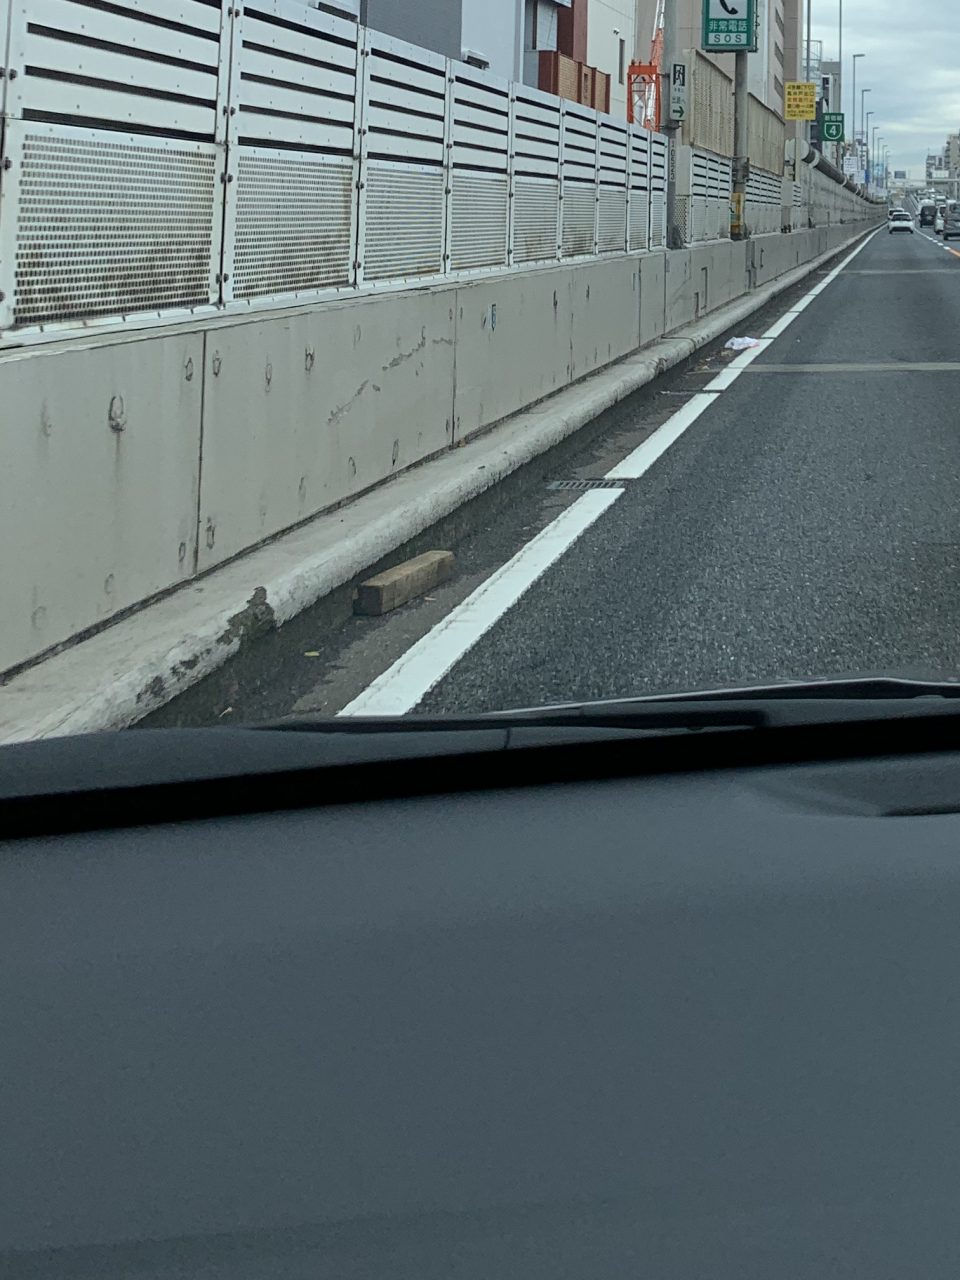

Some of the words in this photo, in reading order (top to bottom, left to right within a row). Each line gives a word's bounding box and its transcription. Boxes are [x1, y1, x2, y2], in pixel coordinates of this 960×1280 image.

[709, 20, 748, 32] 非常電話
[714, 33, 742, 43] SOS
[829, 125, 837, 136] 4
